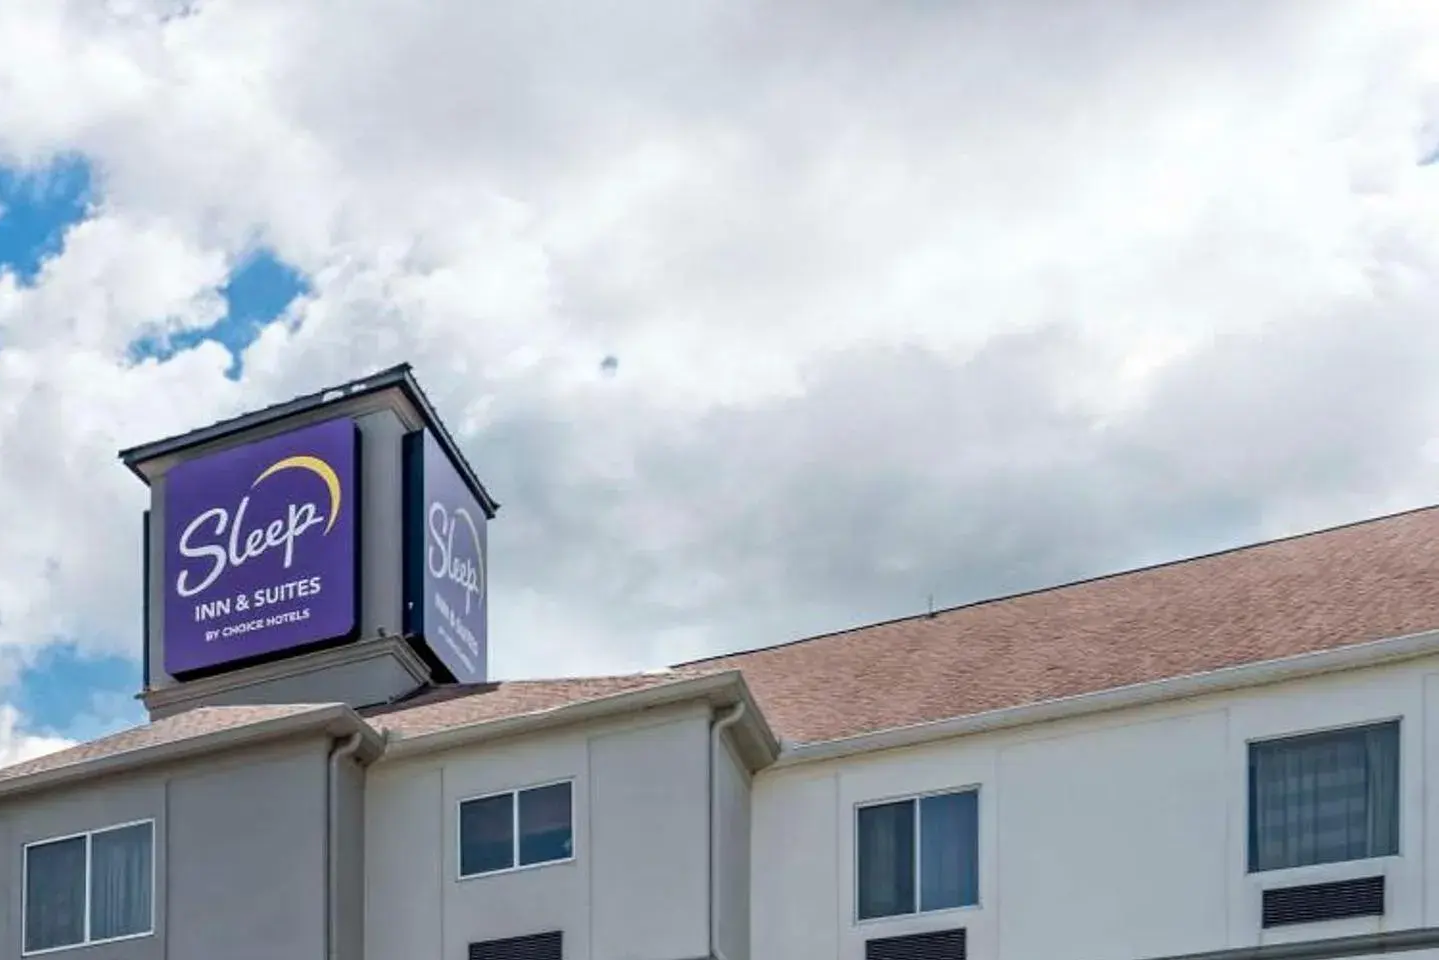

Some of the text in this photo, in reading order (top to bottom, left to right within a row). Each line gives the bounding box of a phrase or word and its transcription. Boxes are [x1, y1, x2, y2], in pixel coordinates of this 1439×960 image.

[176, 496, 324, 598] Sleep
[429, 502, 479, 616] Sleep
[195, 576, 321, 622] INN & SUITES
[205, 607, 311, 642] BY CHOICE HOTELS
